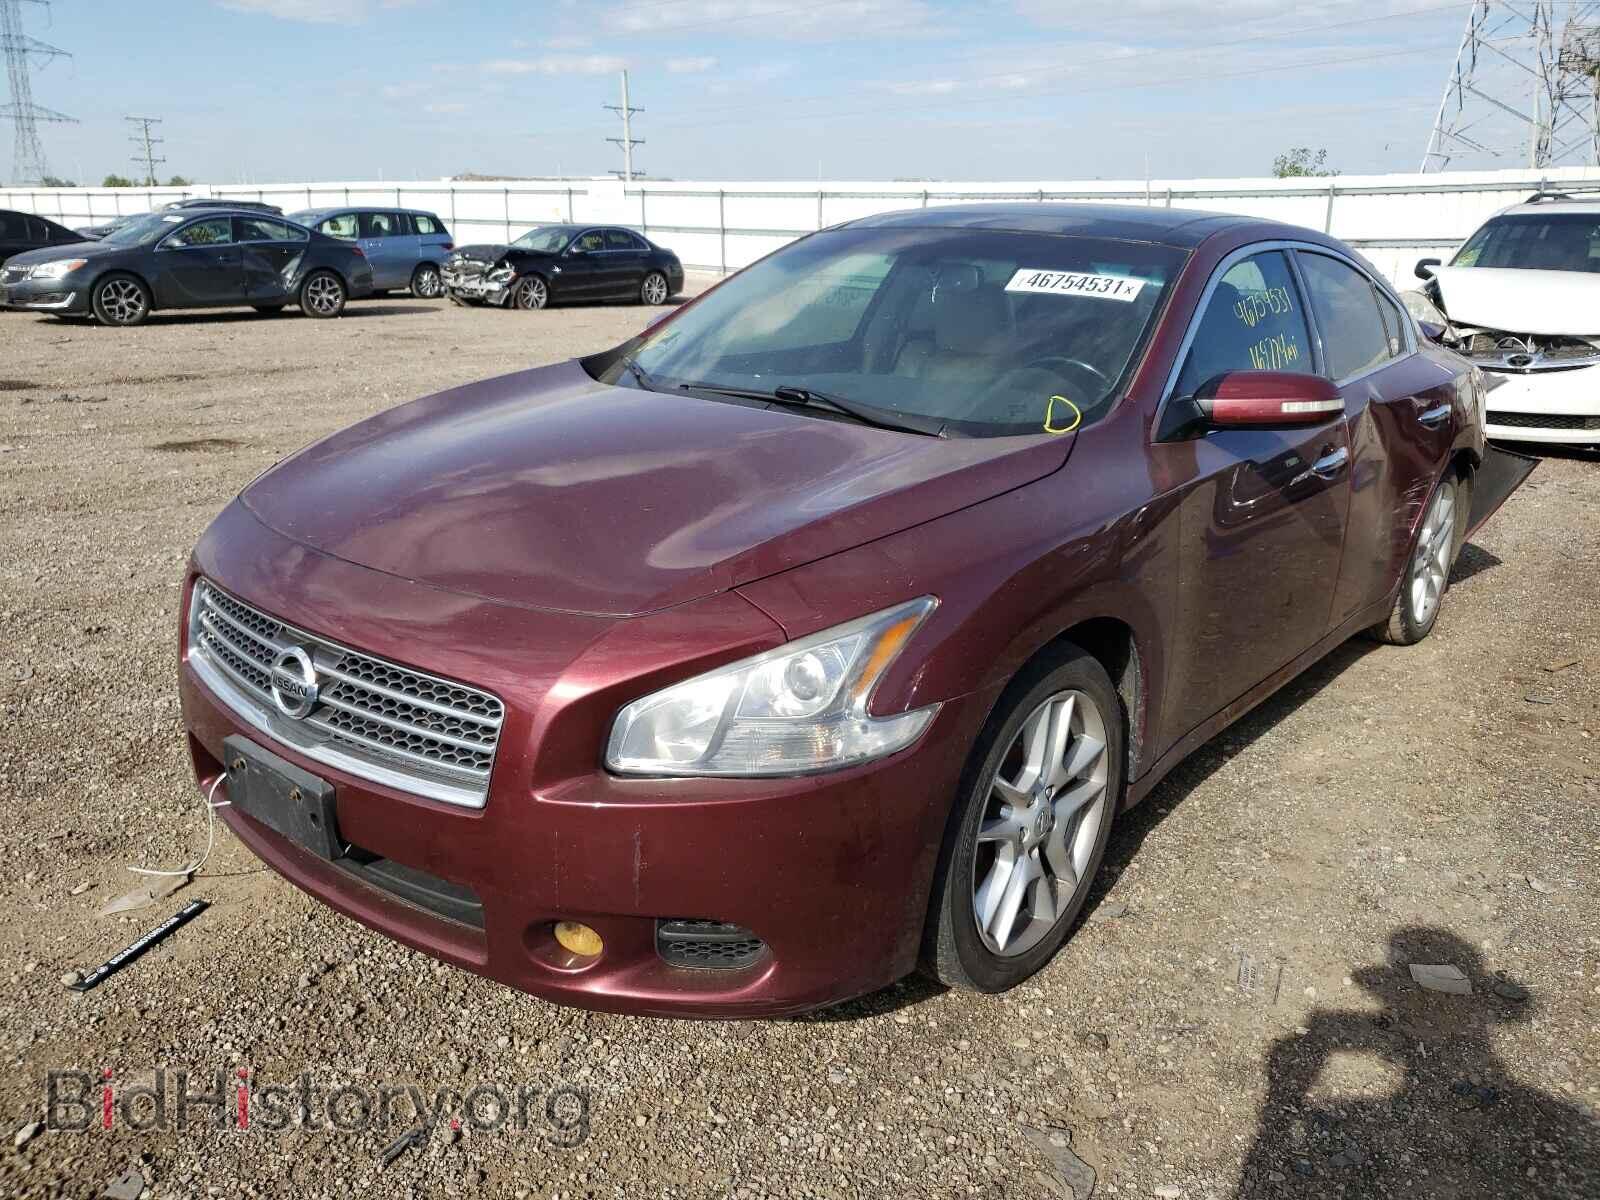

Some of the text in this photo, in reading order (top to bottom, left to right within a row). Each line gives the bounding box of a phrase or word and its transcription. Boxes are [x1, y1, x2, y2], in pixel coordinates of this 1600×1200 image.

[1026, 272, 1125, 295] 46754531
[1232, 286, 1294, 328] 46754531
[1043, 394, 1081, 433] D
[270, 670, 308, 698] NISSAN
